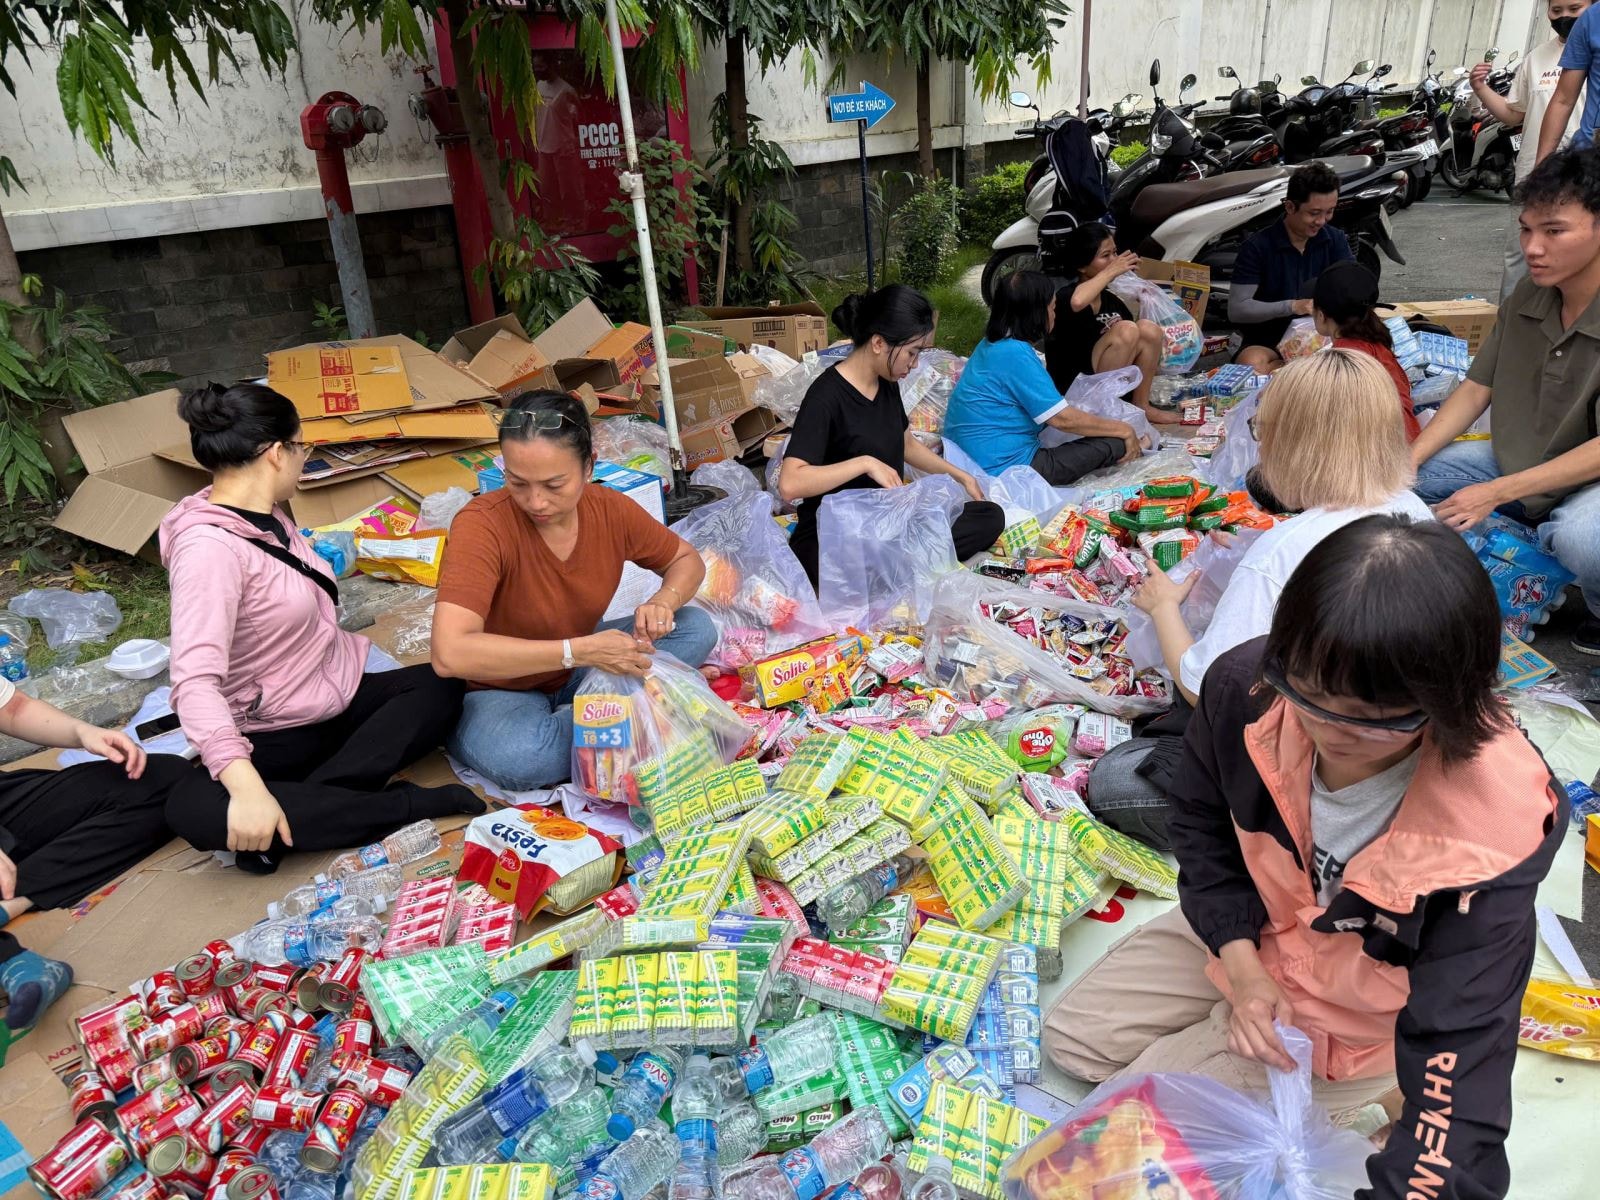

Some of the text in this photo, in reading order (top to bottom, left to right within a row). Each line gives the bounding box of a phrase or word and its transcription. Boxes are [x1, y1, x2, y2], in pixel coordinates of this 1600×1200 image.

[855, 100, 864, 112] XE
[864, 97, 887, 111] KHÁCH
[578, 122, 620, 147] PCCC
[580, 147, 621, 159] FIRE HOSE REEL
[773, 660, 809, 687] Solite
[582, 703, 624, 721] Solite
[772, 1115, 796, 1124] MILO
[808, 1113, 832, 1122] MILO
